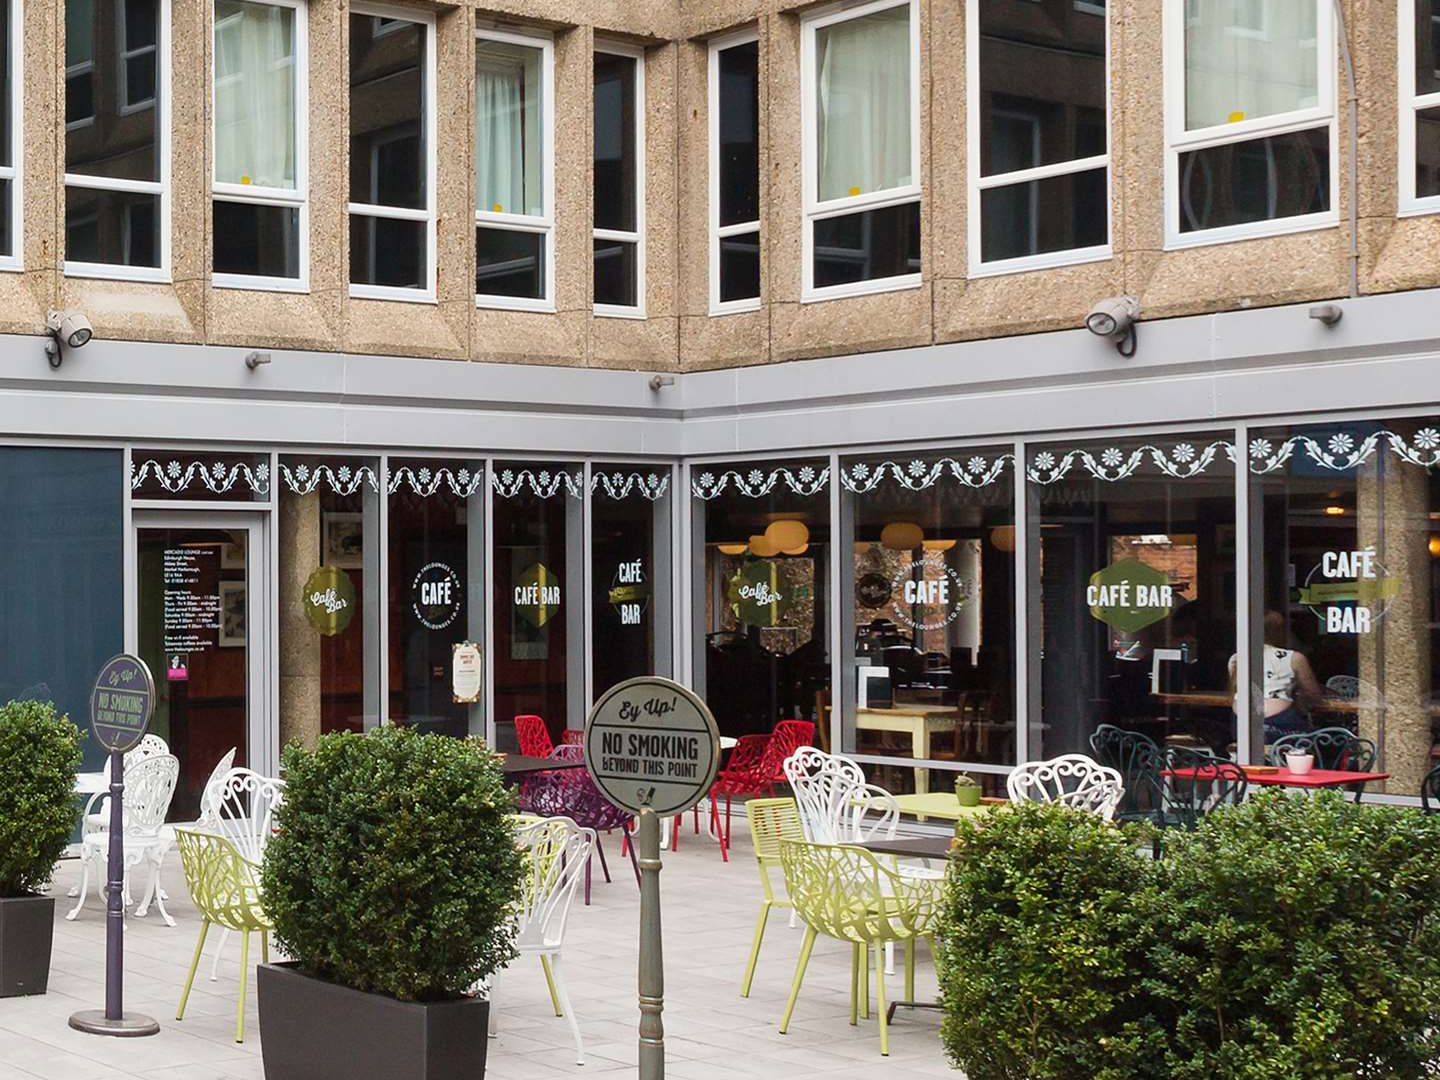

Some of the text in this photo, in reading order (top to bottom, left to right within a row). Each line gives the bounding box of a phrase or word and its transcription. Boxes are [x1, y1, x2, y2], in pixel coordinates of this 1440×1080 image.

[619, 558, 642, 583] CAFÉ
[1322, 545, 1377, 578] CAFÉ
[310, 587, 337, 607] Café
[421, 576, 452, 605] CAFÉ
[514, 582, 560, 605] CAFÉ BAR
[738, 581, 770, 599] Café
[756, 590, 783, 607] Bar
[904, 574, 949, 605] CAFÉ
[1086, 579, 1173, 607] CAFÉ BAR
[326, 598, 348, 614] Bar
[621, 604, 641, 625] BAR
[1327, 606, 1371, 634] BAR
[97, 692, 144, 713] NO SMOKING
[619, 697, 677, 722] Ey Up!
[602, 732, 698, 760] NO SMOKING
[602, 757, 698, 778] BEYOND THIS POINT
